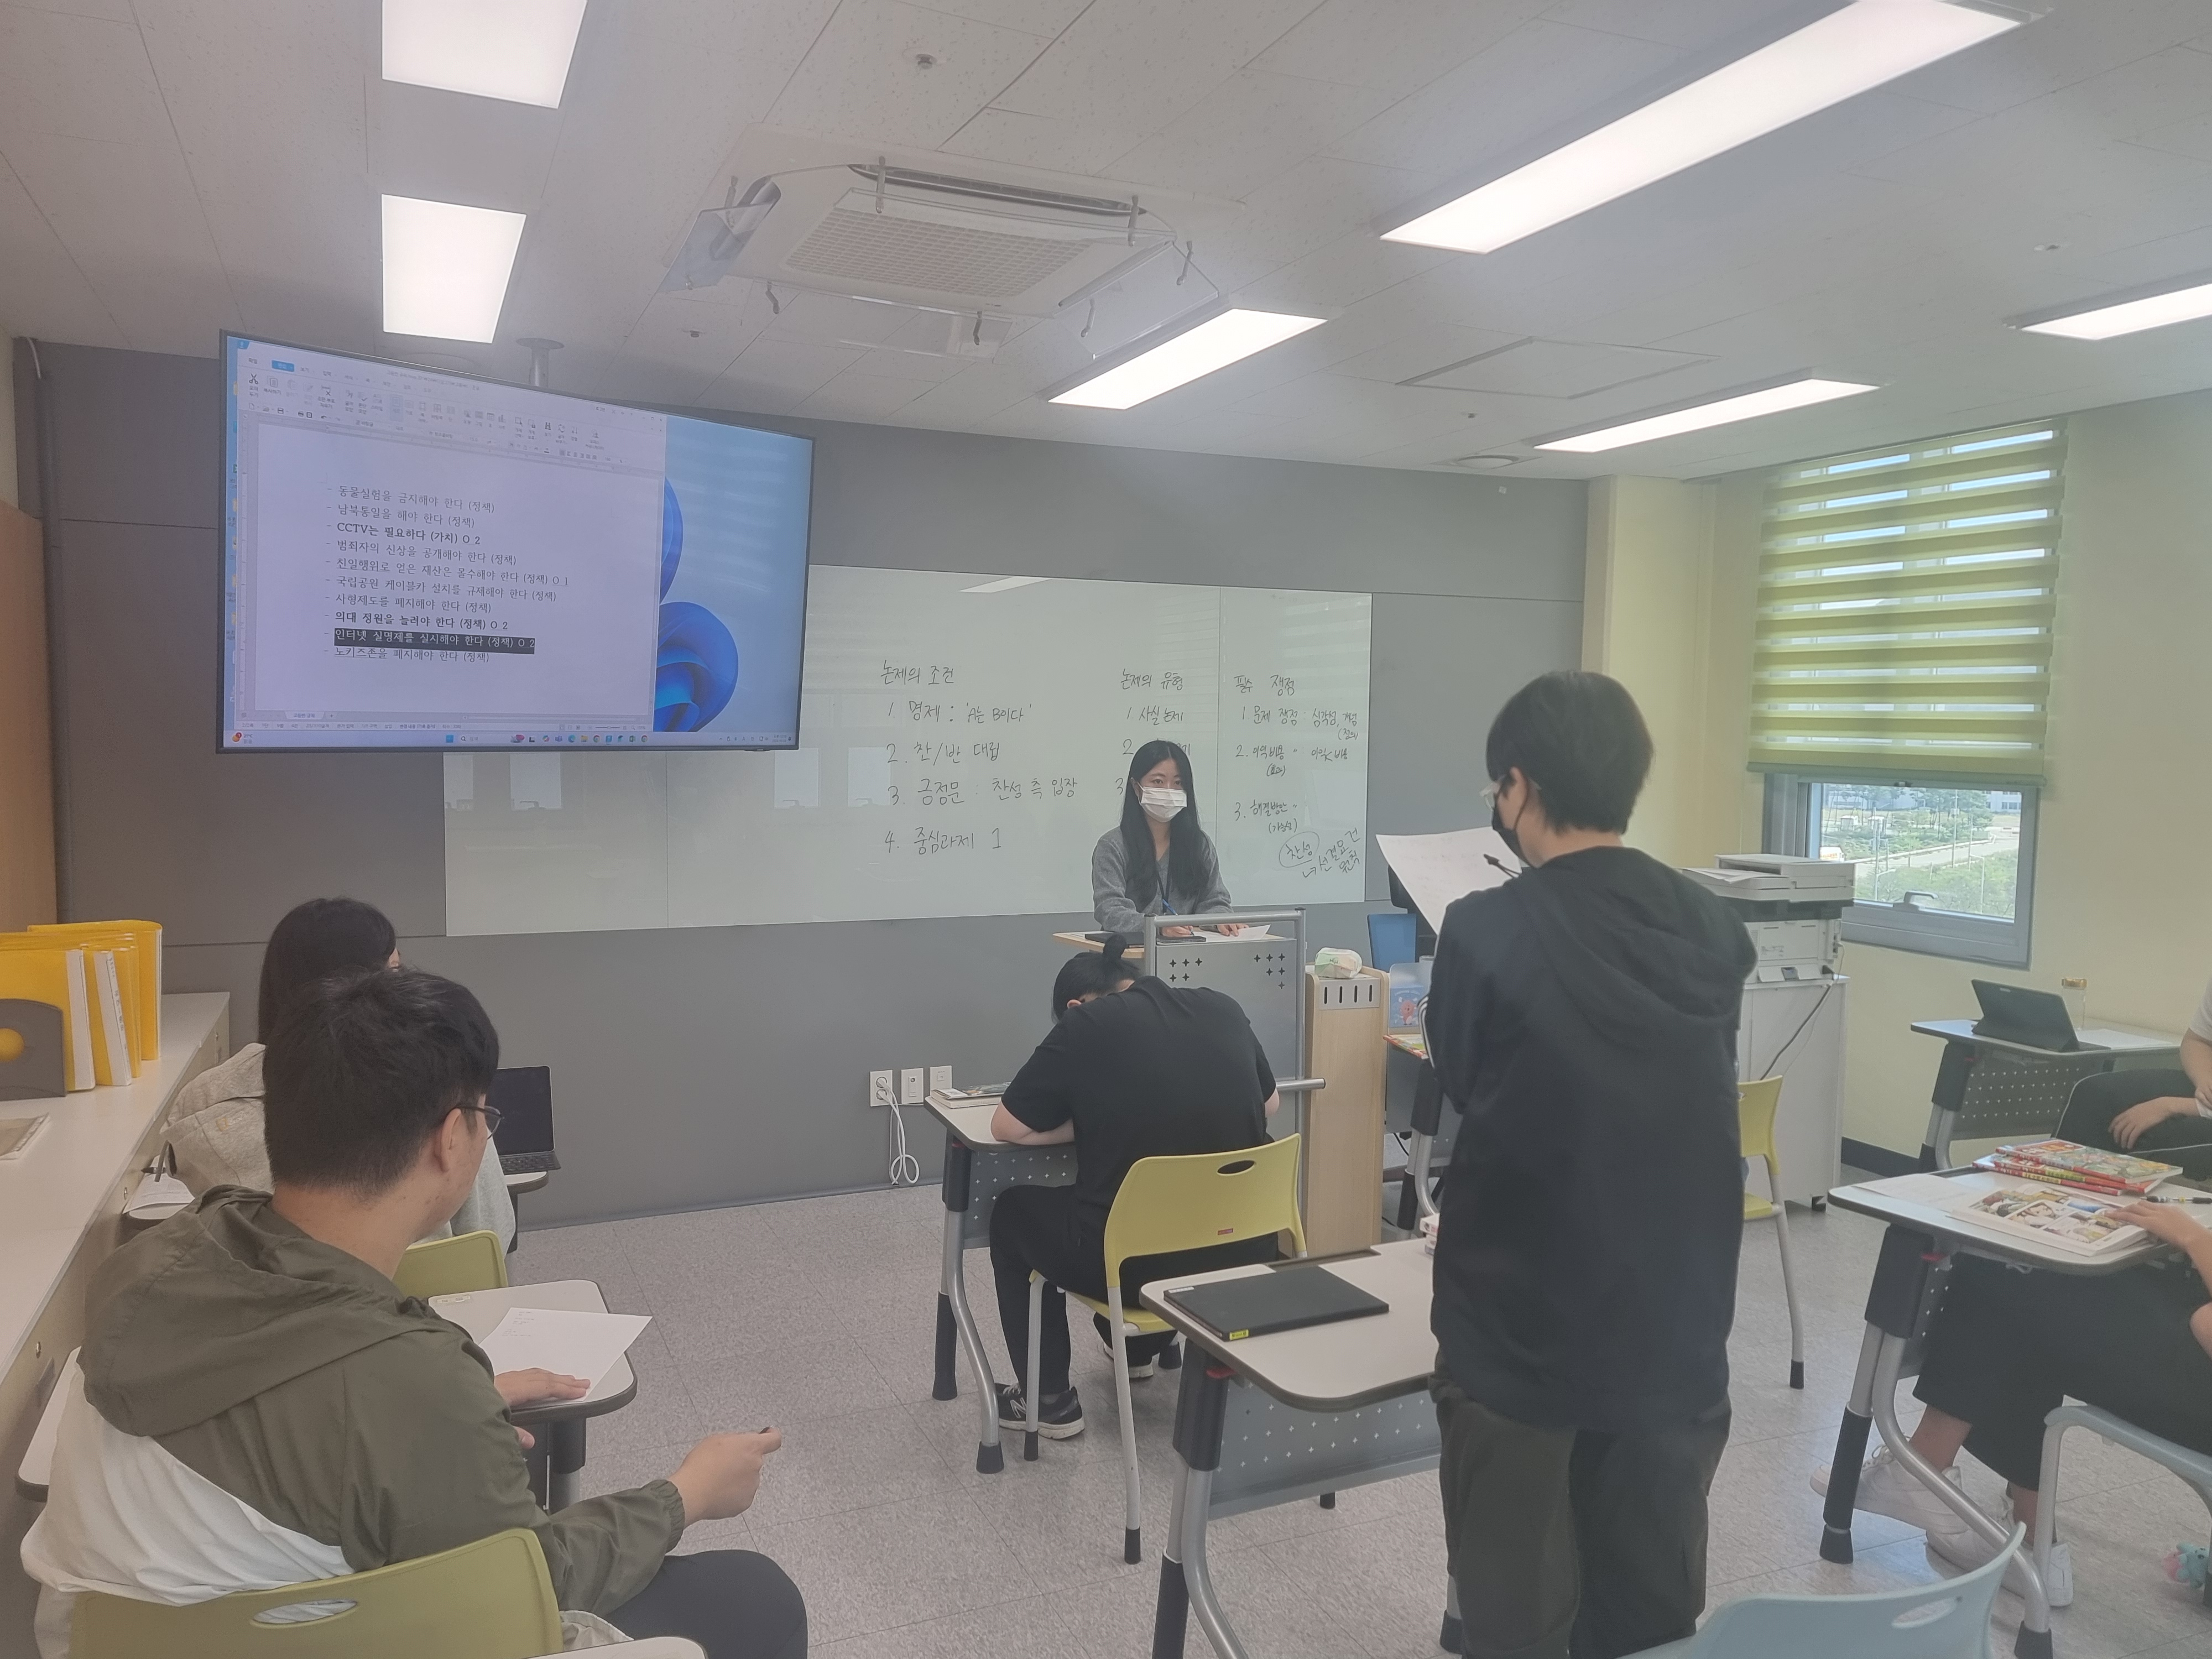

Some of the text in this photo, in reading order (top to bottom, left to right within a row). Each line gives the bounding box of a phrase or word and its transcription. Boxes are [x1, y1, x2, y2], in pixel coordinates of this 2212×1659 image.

[338, 485, 494, 513] 동물실험을 금지해야 한다 (정책)
[338, 504, 474, 528] 남북통일을 해야 한다 (정책)
[337, 522, 379, 536] CCTV는
[384, 526, 426, 541] 필요하다
[430, 530, 458, 544] (가치)
[474, 536, 481, 545] 2
[337, 540, 517, 566] 범죄자의 신상을 공개해야 한다 (정책)
[337, 557, 390, 572] 친일행위로
[397, 562, 416, 575] 얻은
[421, 565, 452, 578] 재산은
[457, 567, 495, 581] 몰수해야
[500, 571, 519, 583] 한다
[523, 573, 548, 585] (정책)
[336, 576, 556, 602] 국립공원 케이블카 설치를 규제해야 한다 (정책)
[335, 593, 390, 607] 사형제도를
[441, 600, 461, 612] 한다
[465, 602, 491, 613] (정책)
[335, 611, 357, 623] 의대
[362, 613, 394, 625] 정원을
[399, 615, 431, 627] 늘려야
[436, 617, 455, 628] 한다
[460, 618, 486, 630] (정책)
[503, 622, 508, 630] 2
[335, 629, 367, 641] 인터넷
[373, 630, 414, 643] 실명제를
[420, 633, 459, 645] 실시해야
[465, 635, 483, 646] 한다
[488, 637, 513, 648] (정책)
[529, 639, 535, 648] 2
[335, 646, 388, 659] 노키즈존을
[440, 651, 458, 662] 한다
[463, 652, 489, 662] (정책)
[880, 660, 954, 685] 논제의 조건
[1120, 668, 1183, 691] 논제의 유형
[1234, 675, 1254, 693] 필수
[909, 700, 941, 722] 명제
[1139, 705, 1160, 726] 사실
[1163, 707, 1184, 722] 논제
[1254, 705, 1271, 724] 문제
[886, 742, 1000, 766] 2. 찬/반 대립
[1235, 744, 1249, 758] 2.
[917, 778, 965, 806] 긍정문
[992, 778, 1022, 801] 찬성
[1031, 778, 1042, 799] 측
[1052, 778, 1078, 797] 입장
[1234, 802, 1246, 821] 3.
[885, 830, 900, 853] 4.
[914, 826, 974, 855] 중심과제
[1285, 841, 1313, 860] 찬성
